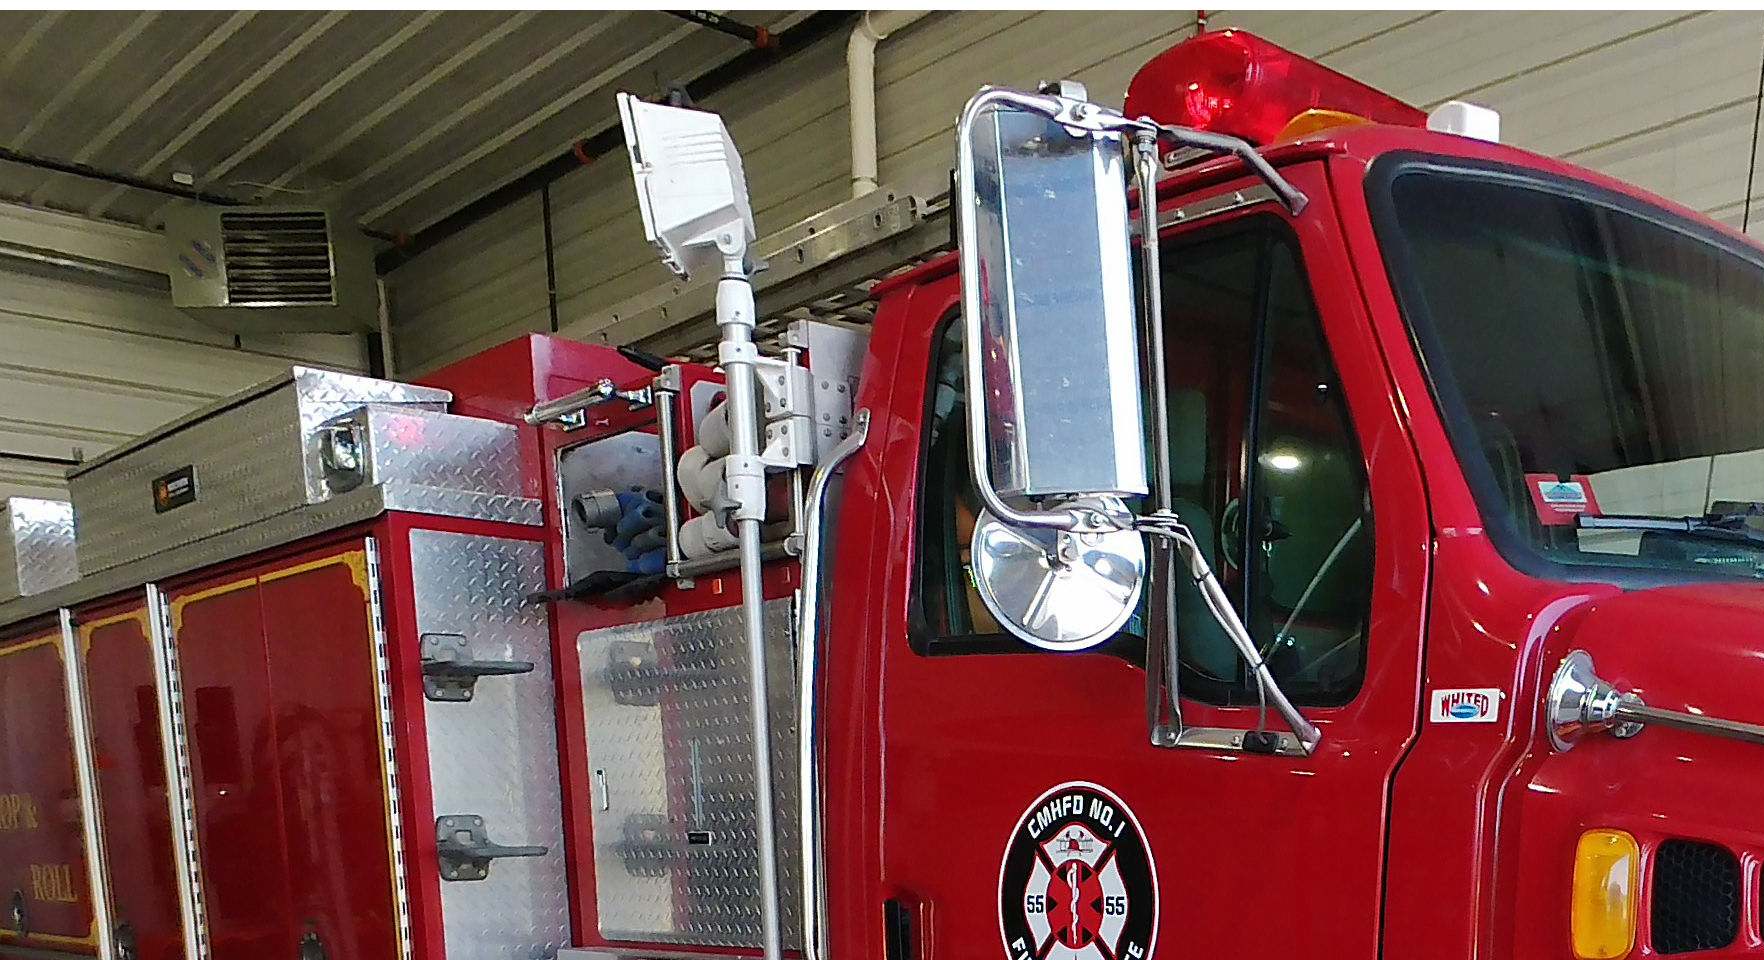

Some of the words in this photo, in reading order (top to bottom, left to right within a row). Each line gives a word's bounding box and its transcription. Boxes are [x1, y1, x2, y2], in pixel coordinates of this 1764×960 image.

[1441, 692, 1489, 717] WHITED
[1028, 795, 1083, 839] CMHFD
[30, 864, 78, 903] ROLL
[1026, 894, 1044, 914] 55
[1105, 896, 1125, 916] 55
